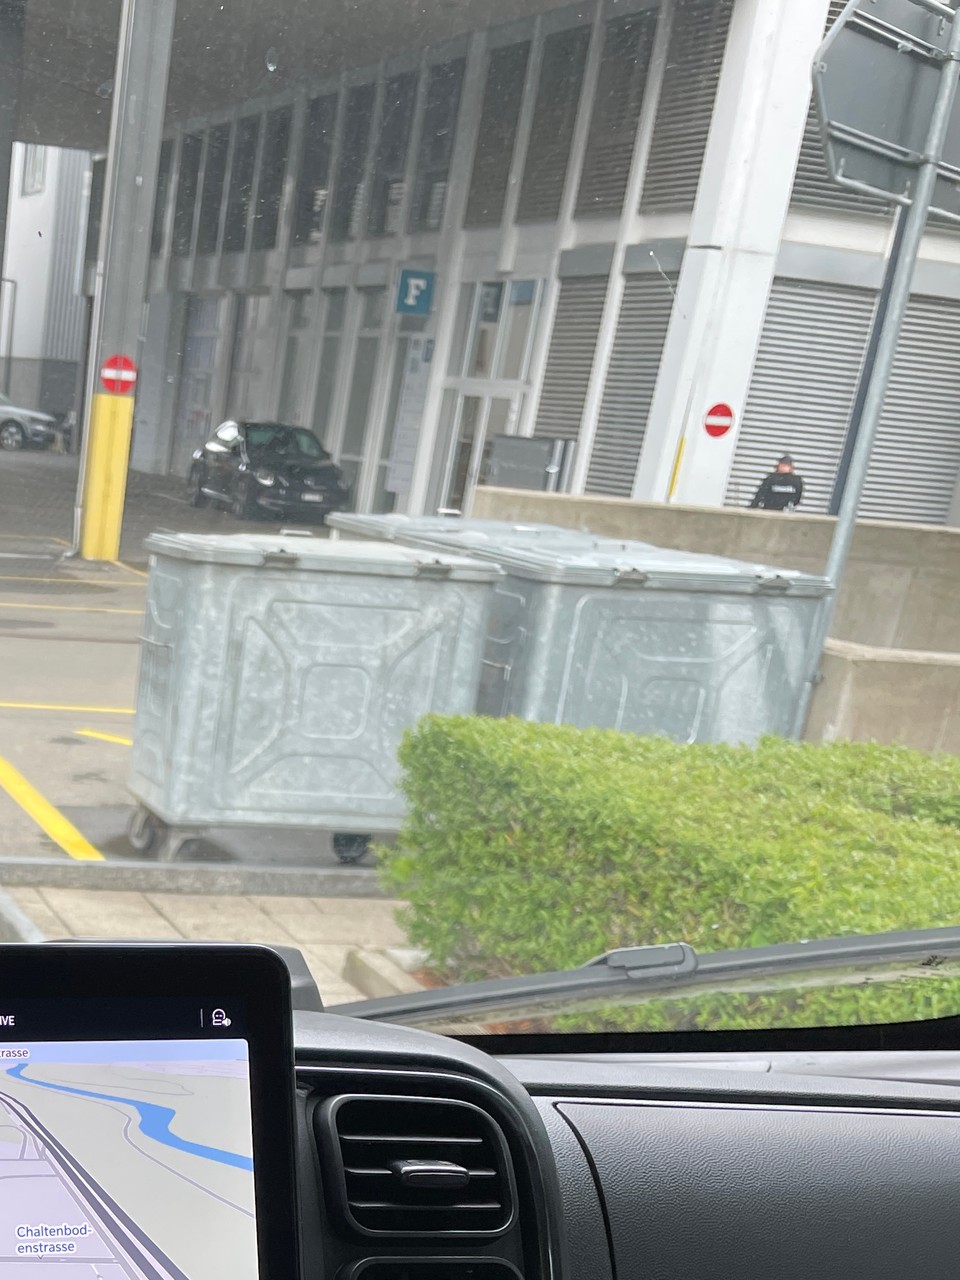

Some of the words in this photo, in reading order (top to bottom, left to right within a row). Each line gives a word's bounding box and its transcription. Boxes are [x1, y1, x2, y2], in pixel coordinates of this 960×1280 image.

[404, 278, 427, 306] F
[17, 1224, 92, 1237] Chaltenbod-
[17, 1242, 75, 1253] enstrasse
